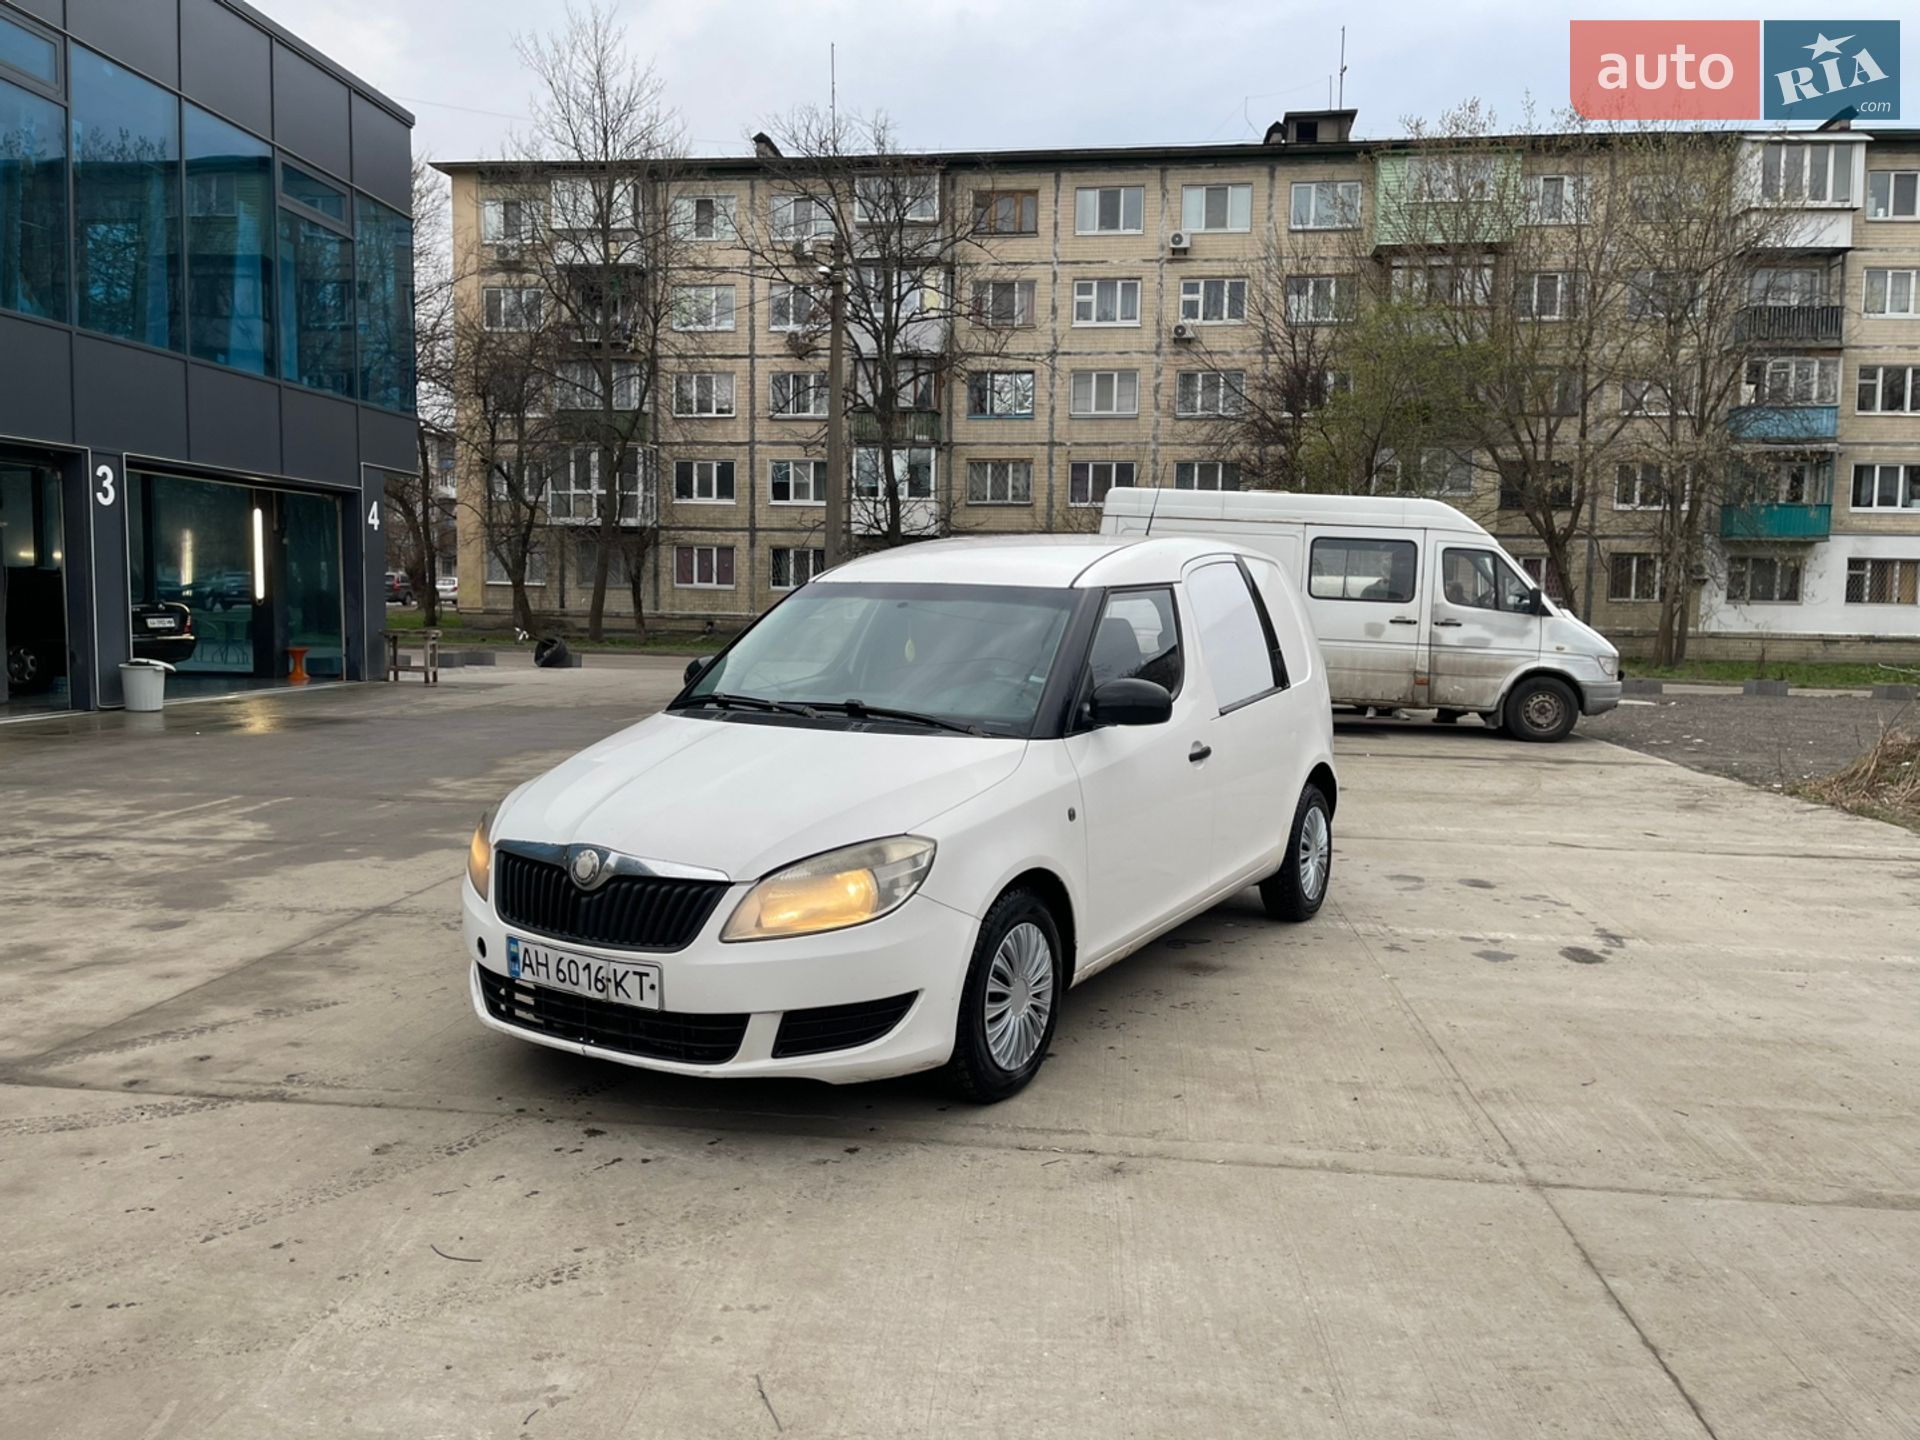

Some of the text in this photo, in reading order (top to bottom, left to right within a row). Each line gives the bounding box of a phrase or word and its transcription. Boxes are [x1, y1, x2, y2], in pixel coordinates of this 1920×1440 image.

[95, 465, 116, 506] 3
[367, 501, 380, 531] 4
[521, 947, 650, 1001] AH 6016 KT
